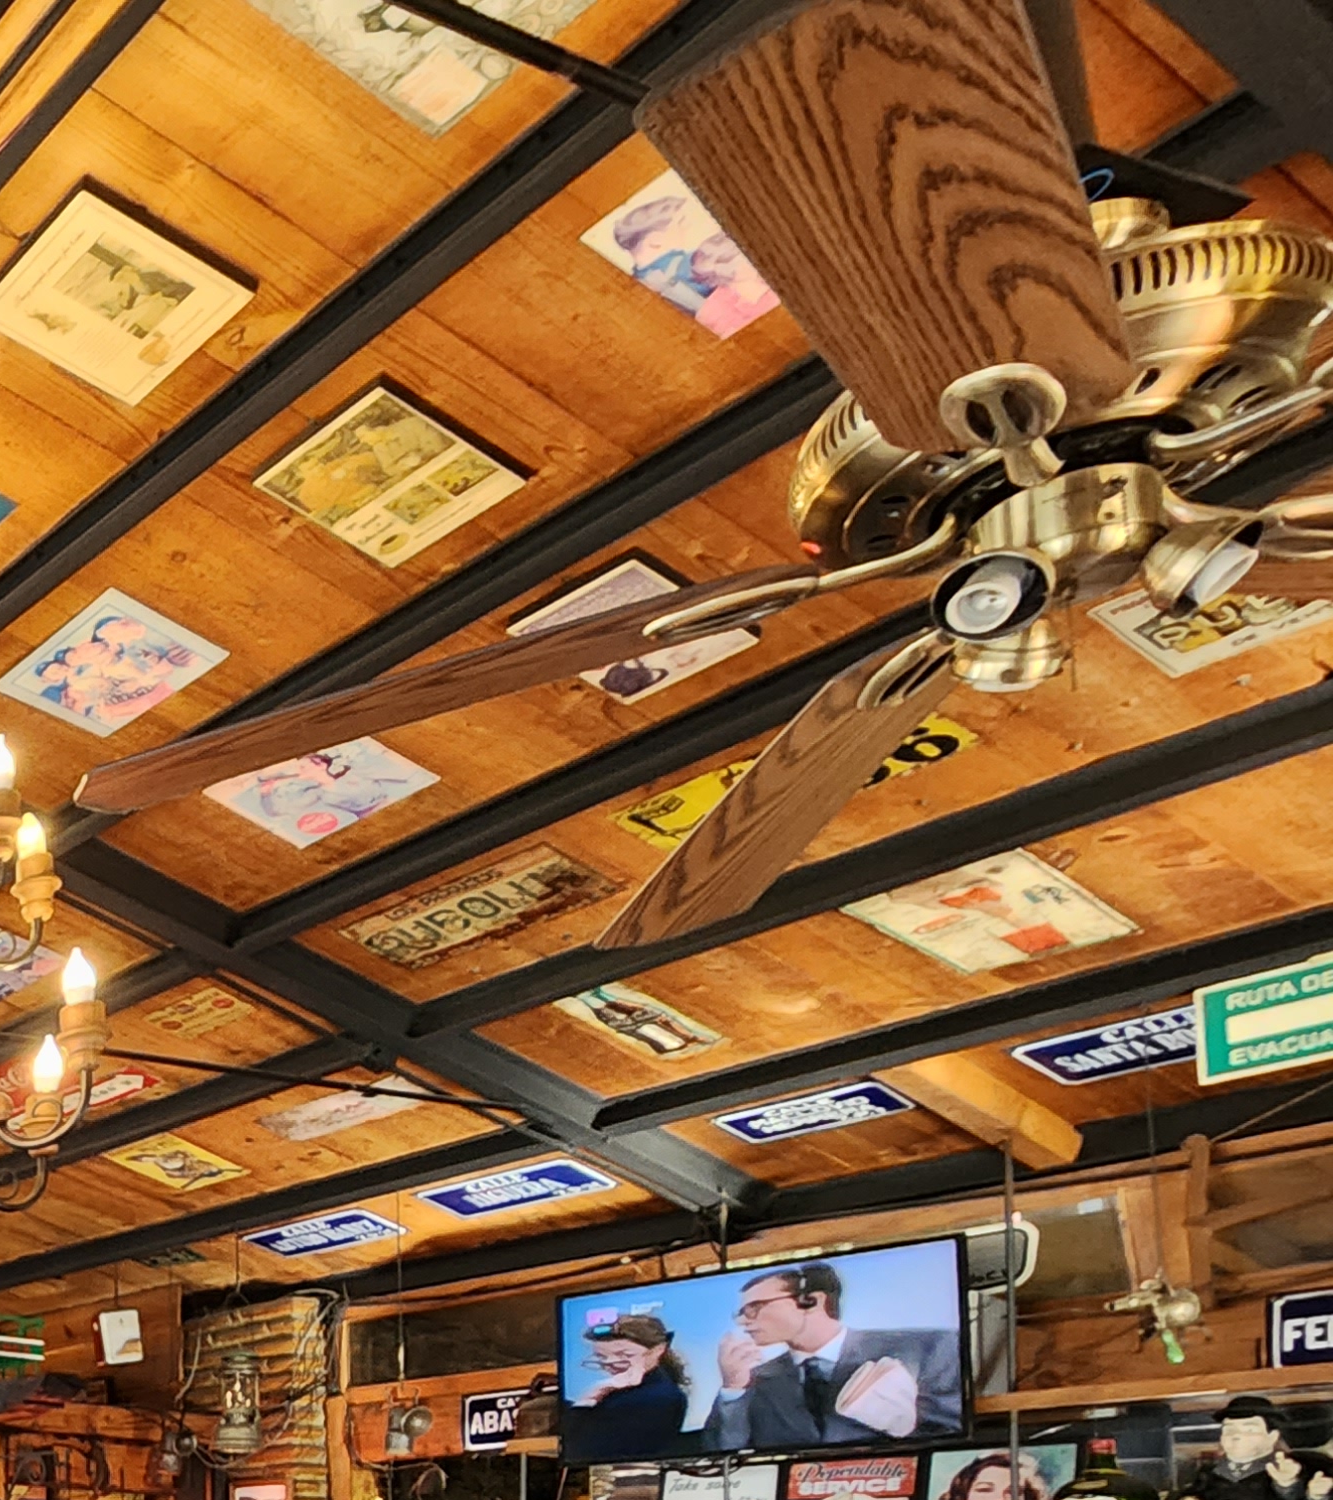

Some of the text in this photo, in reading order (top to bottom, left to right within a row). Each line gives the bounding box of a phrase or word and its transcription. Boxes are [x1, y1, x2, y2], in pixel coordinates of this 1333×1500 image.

[1225, 981, 1297, 1011] RUTA
[1054, 1026, 1197, 1074] SANTA RO
[460, 1177, 570, 1208] HIGUERA
[462, 1172, 529, 1193] CALLE
[279, 1220, 332, 1237] CALLE
[1283, 1313, 1333, 1352] FE
[496, 1397, 521, 1411] CA
[797, 1458, 907, 1482] Dependable
[669, 1478, 699, 1493] Take
[798, 1477, 903, 1496] SERVICE
